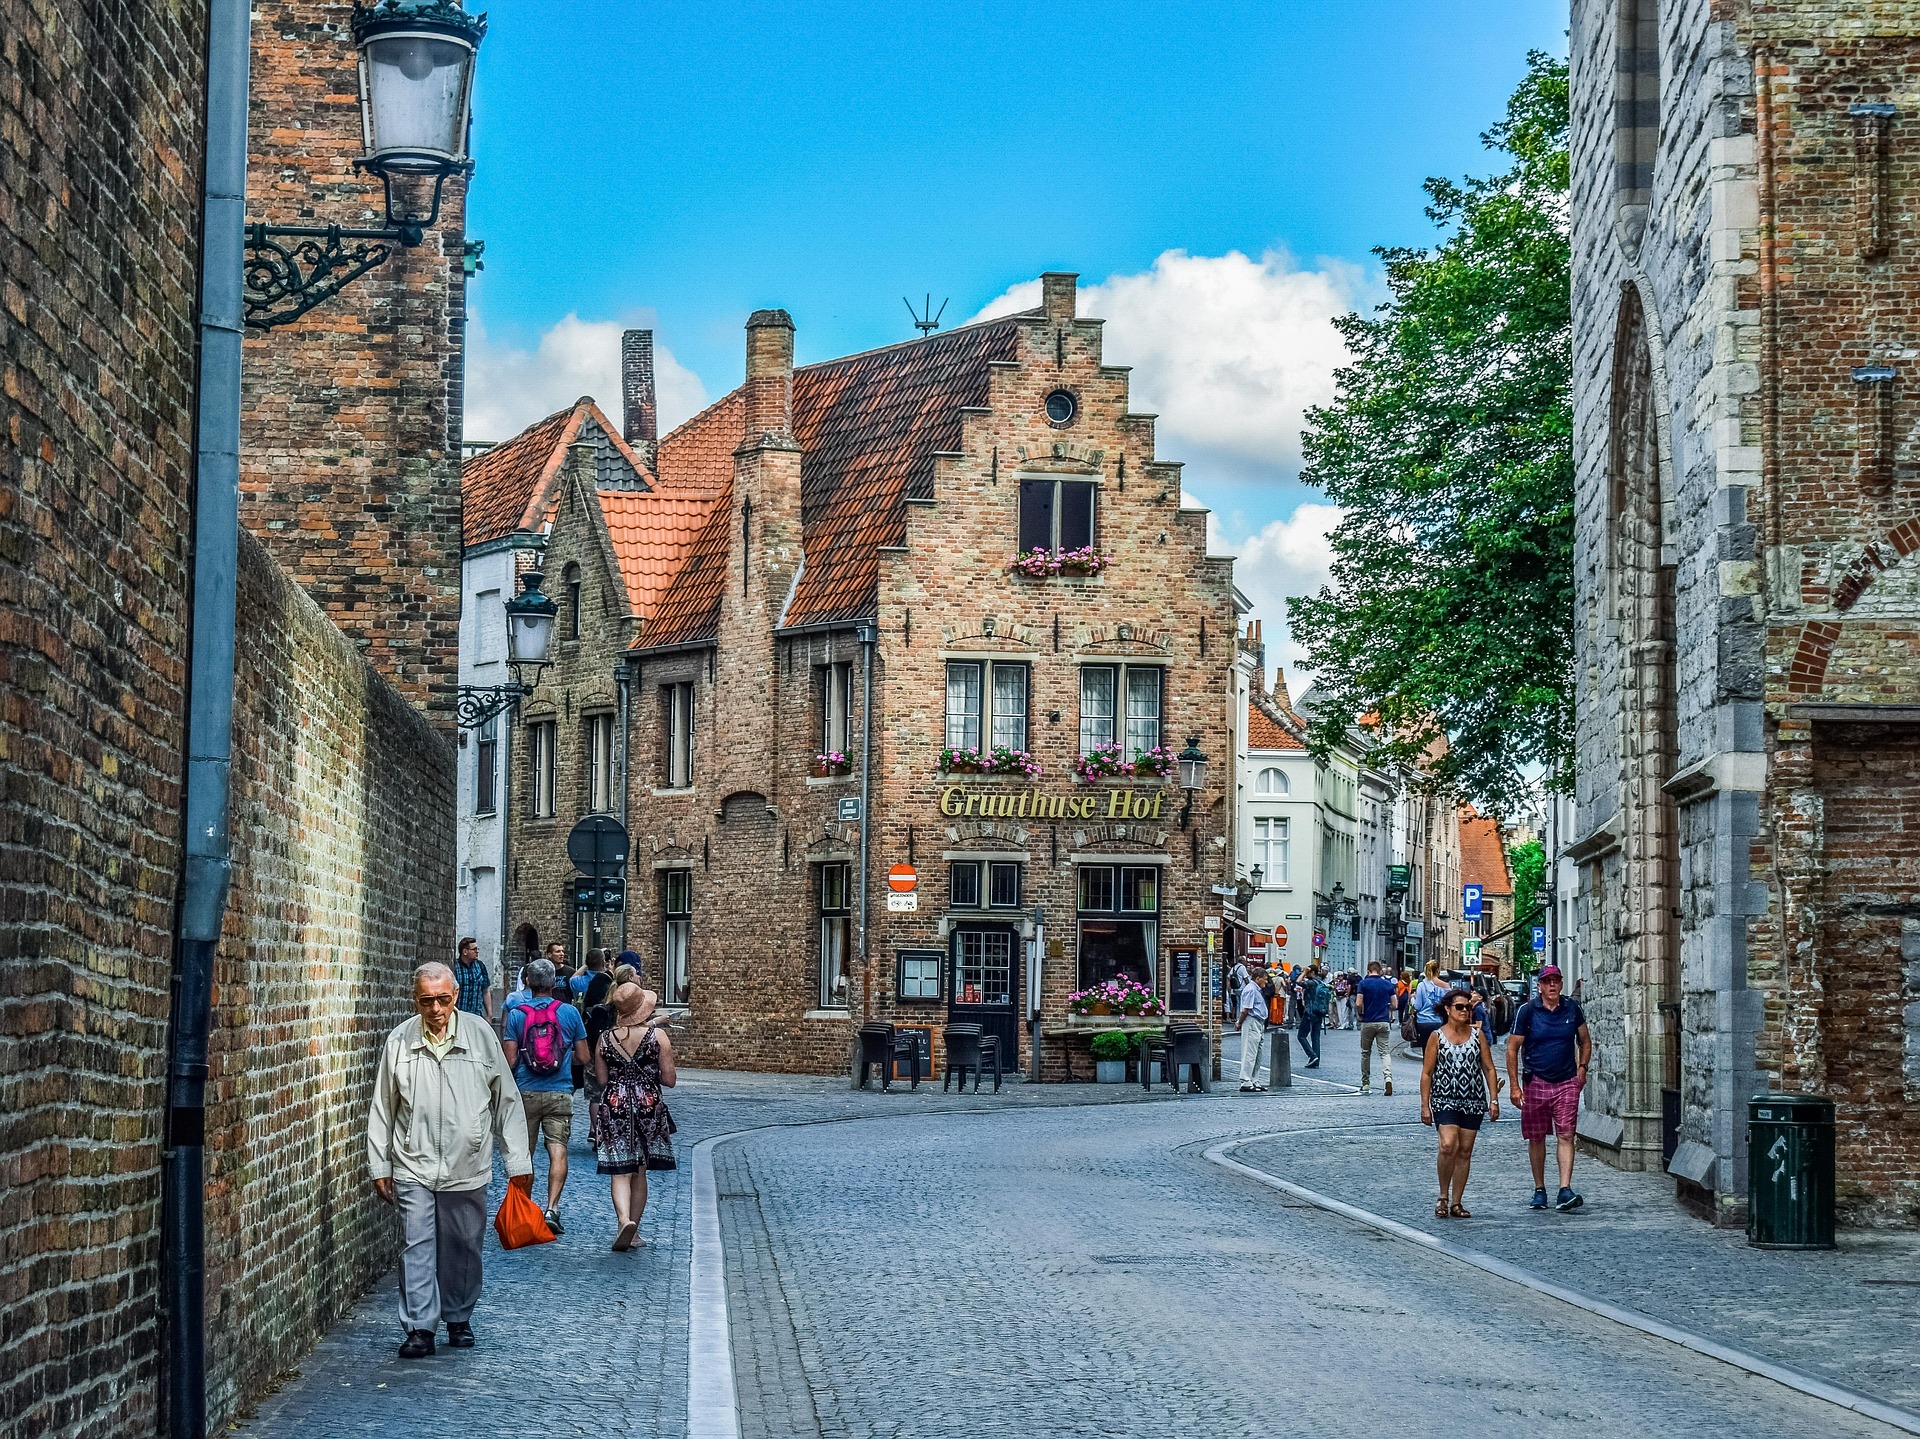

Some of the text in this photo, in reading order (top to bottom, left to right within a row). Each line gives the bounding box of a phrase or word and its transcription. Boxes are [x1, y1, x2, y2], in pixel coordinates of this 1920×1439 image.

[940, 785, 1167, 820] Gruuthuse Hof
[1466, 888, 1480, 907] P
[1534, 930, 1543, 942] P
